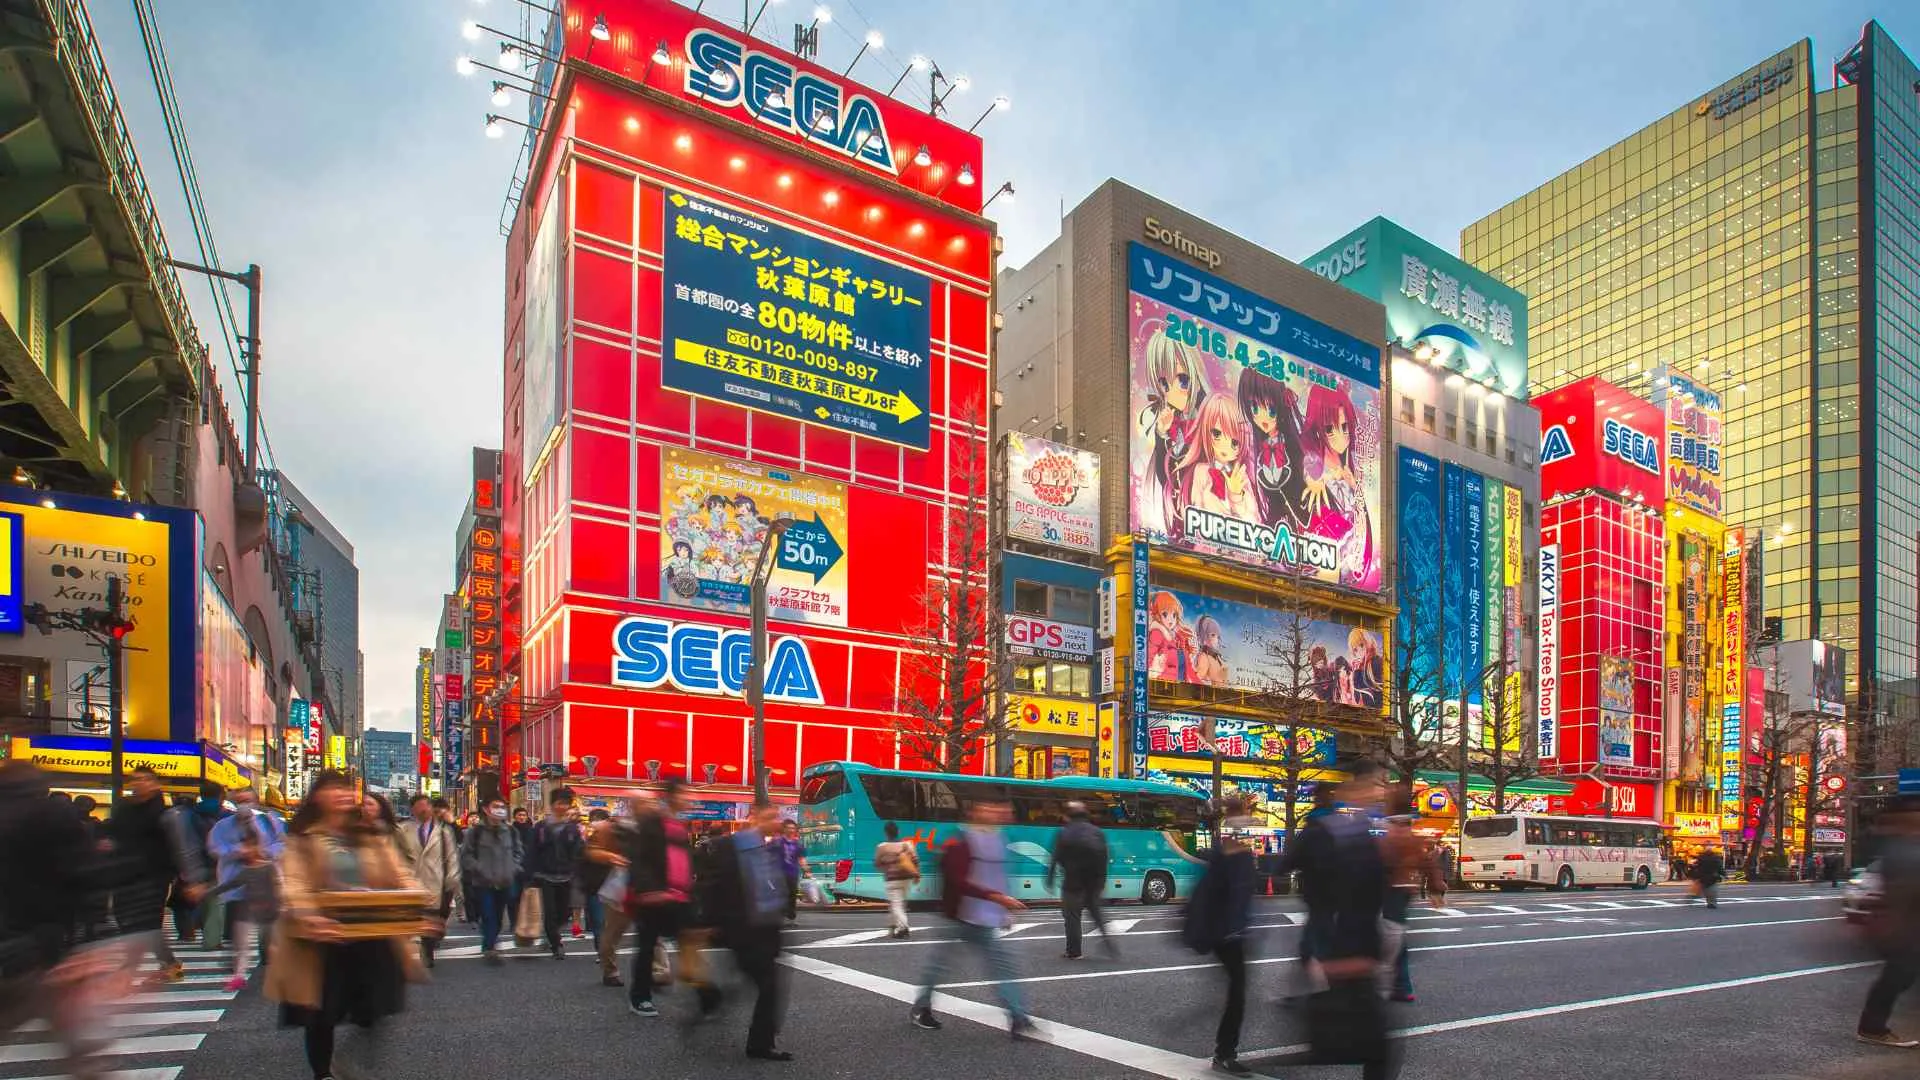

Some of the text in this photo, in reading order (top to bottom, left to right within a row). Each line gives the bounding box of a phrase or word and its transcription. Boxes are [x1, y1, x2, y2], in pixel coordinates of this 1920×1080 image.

[685, 28, 898, 175] SEGA
[1144, 216, 1222, 268] Sofmap
[675, 214, 922, 306] 総合マンションギャラリー
[756, 266, 856, 318] 秋葉原館
[1143, 257, 1372, 372] ソフマップ アミューズメント館
[751, 335, 879, 382] 0120-009-897
[704, 348, 898, 411] 住友不動産秋葉原ビル8F
[1604, 418, 1660, 475] SEGA
[1671, 431, 1720, 475] 高額買取
[784, 527, 827, 544] ここから
[38, 543, 156, 567] SHISEIDO
[90, 569, 147, 586] KOSÉ
[1541, 550, 1555, 597] AKKY
[53, 585, 144, 607] Kanbo
[768, 595, 821, 614] 秋葉原新館
[780, 586, 830, 603] クラブセガ
[1008, 619, 1063, 648] GPS
[1065, 641, 1087, 651] next
[612, 617, 825, 704] SEGA
[1540, 677, 1555, 717] Shop
[1047, 709, 1079, 727] 松屋
[31, 754, 113, 768] Matsumot
[1102, 749, 1112, 778] 松屋
[1619, 786, 1636, 812] SEGA
[1545, 848, 1626, 863] YUNAGI
